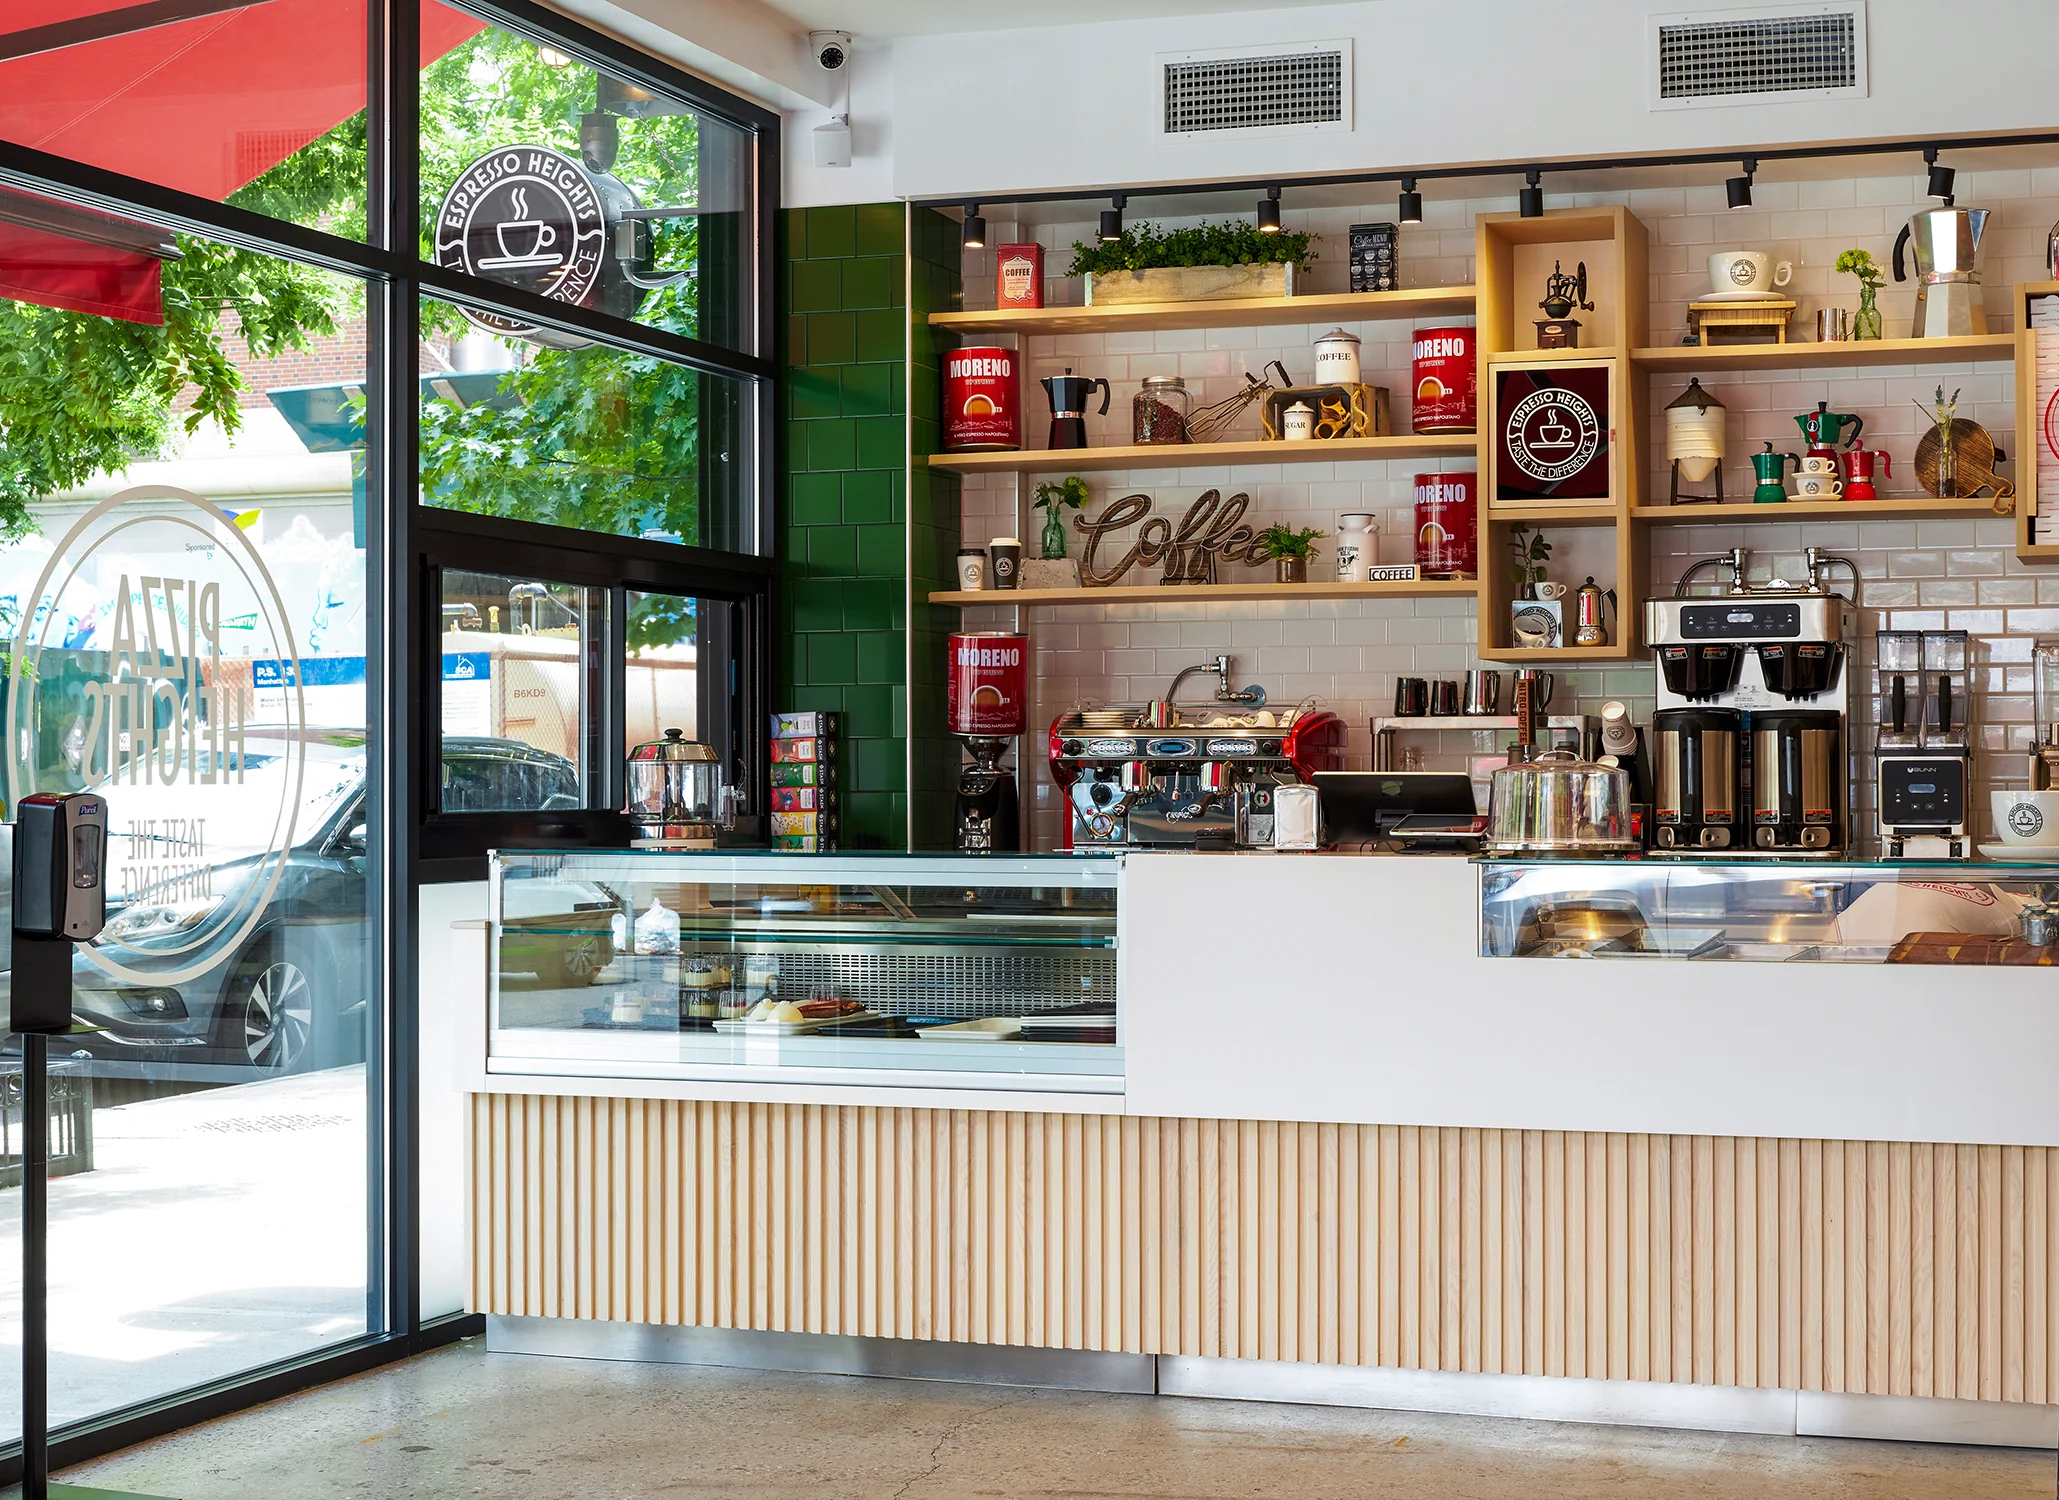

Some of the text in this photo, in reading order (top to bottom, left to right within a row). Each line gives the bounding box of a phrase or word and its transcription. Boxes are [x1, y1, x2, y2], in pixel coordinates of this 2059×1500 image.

[445, 153, 597, 229] ESPRESSO HEIGHTS
[1005, 268, 1030, 277] COFFEE
[1316, 352, 1351, 362] COFFEE
[950, 359, 1010, 378] MORENO
[1512, 392, 1593, 428] ESPRESSO HEIGHTS
[1285, 421, 1306, 429] SUGAR
[1511, 440, 1595, 478] TASTE THE DIFFERENCE
[1072, 488, 1273, 588] Coffee
[185, 542, 216, 553] Sponsored
[1372, 569, 1412, 580] COFFEE
[958, 648, 1019, 667] MORENO
[257, 667, 277, 677] P.S.
[455, 666, 473, 675] SCA
[514, 688, 546, 698] B6KD9
[1519, 682, 1528, 743] NITRO COFFEE
